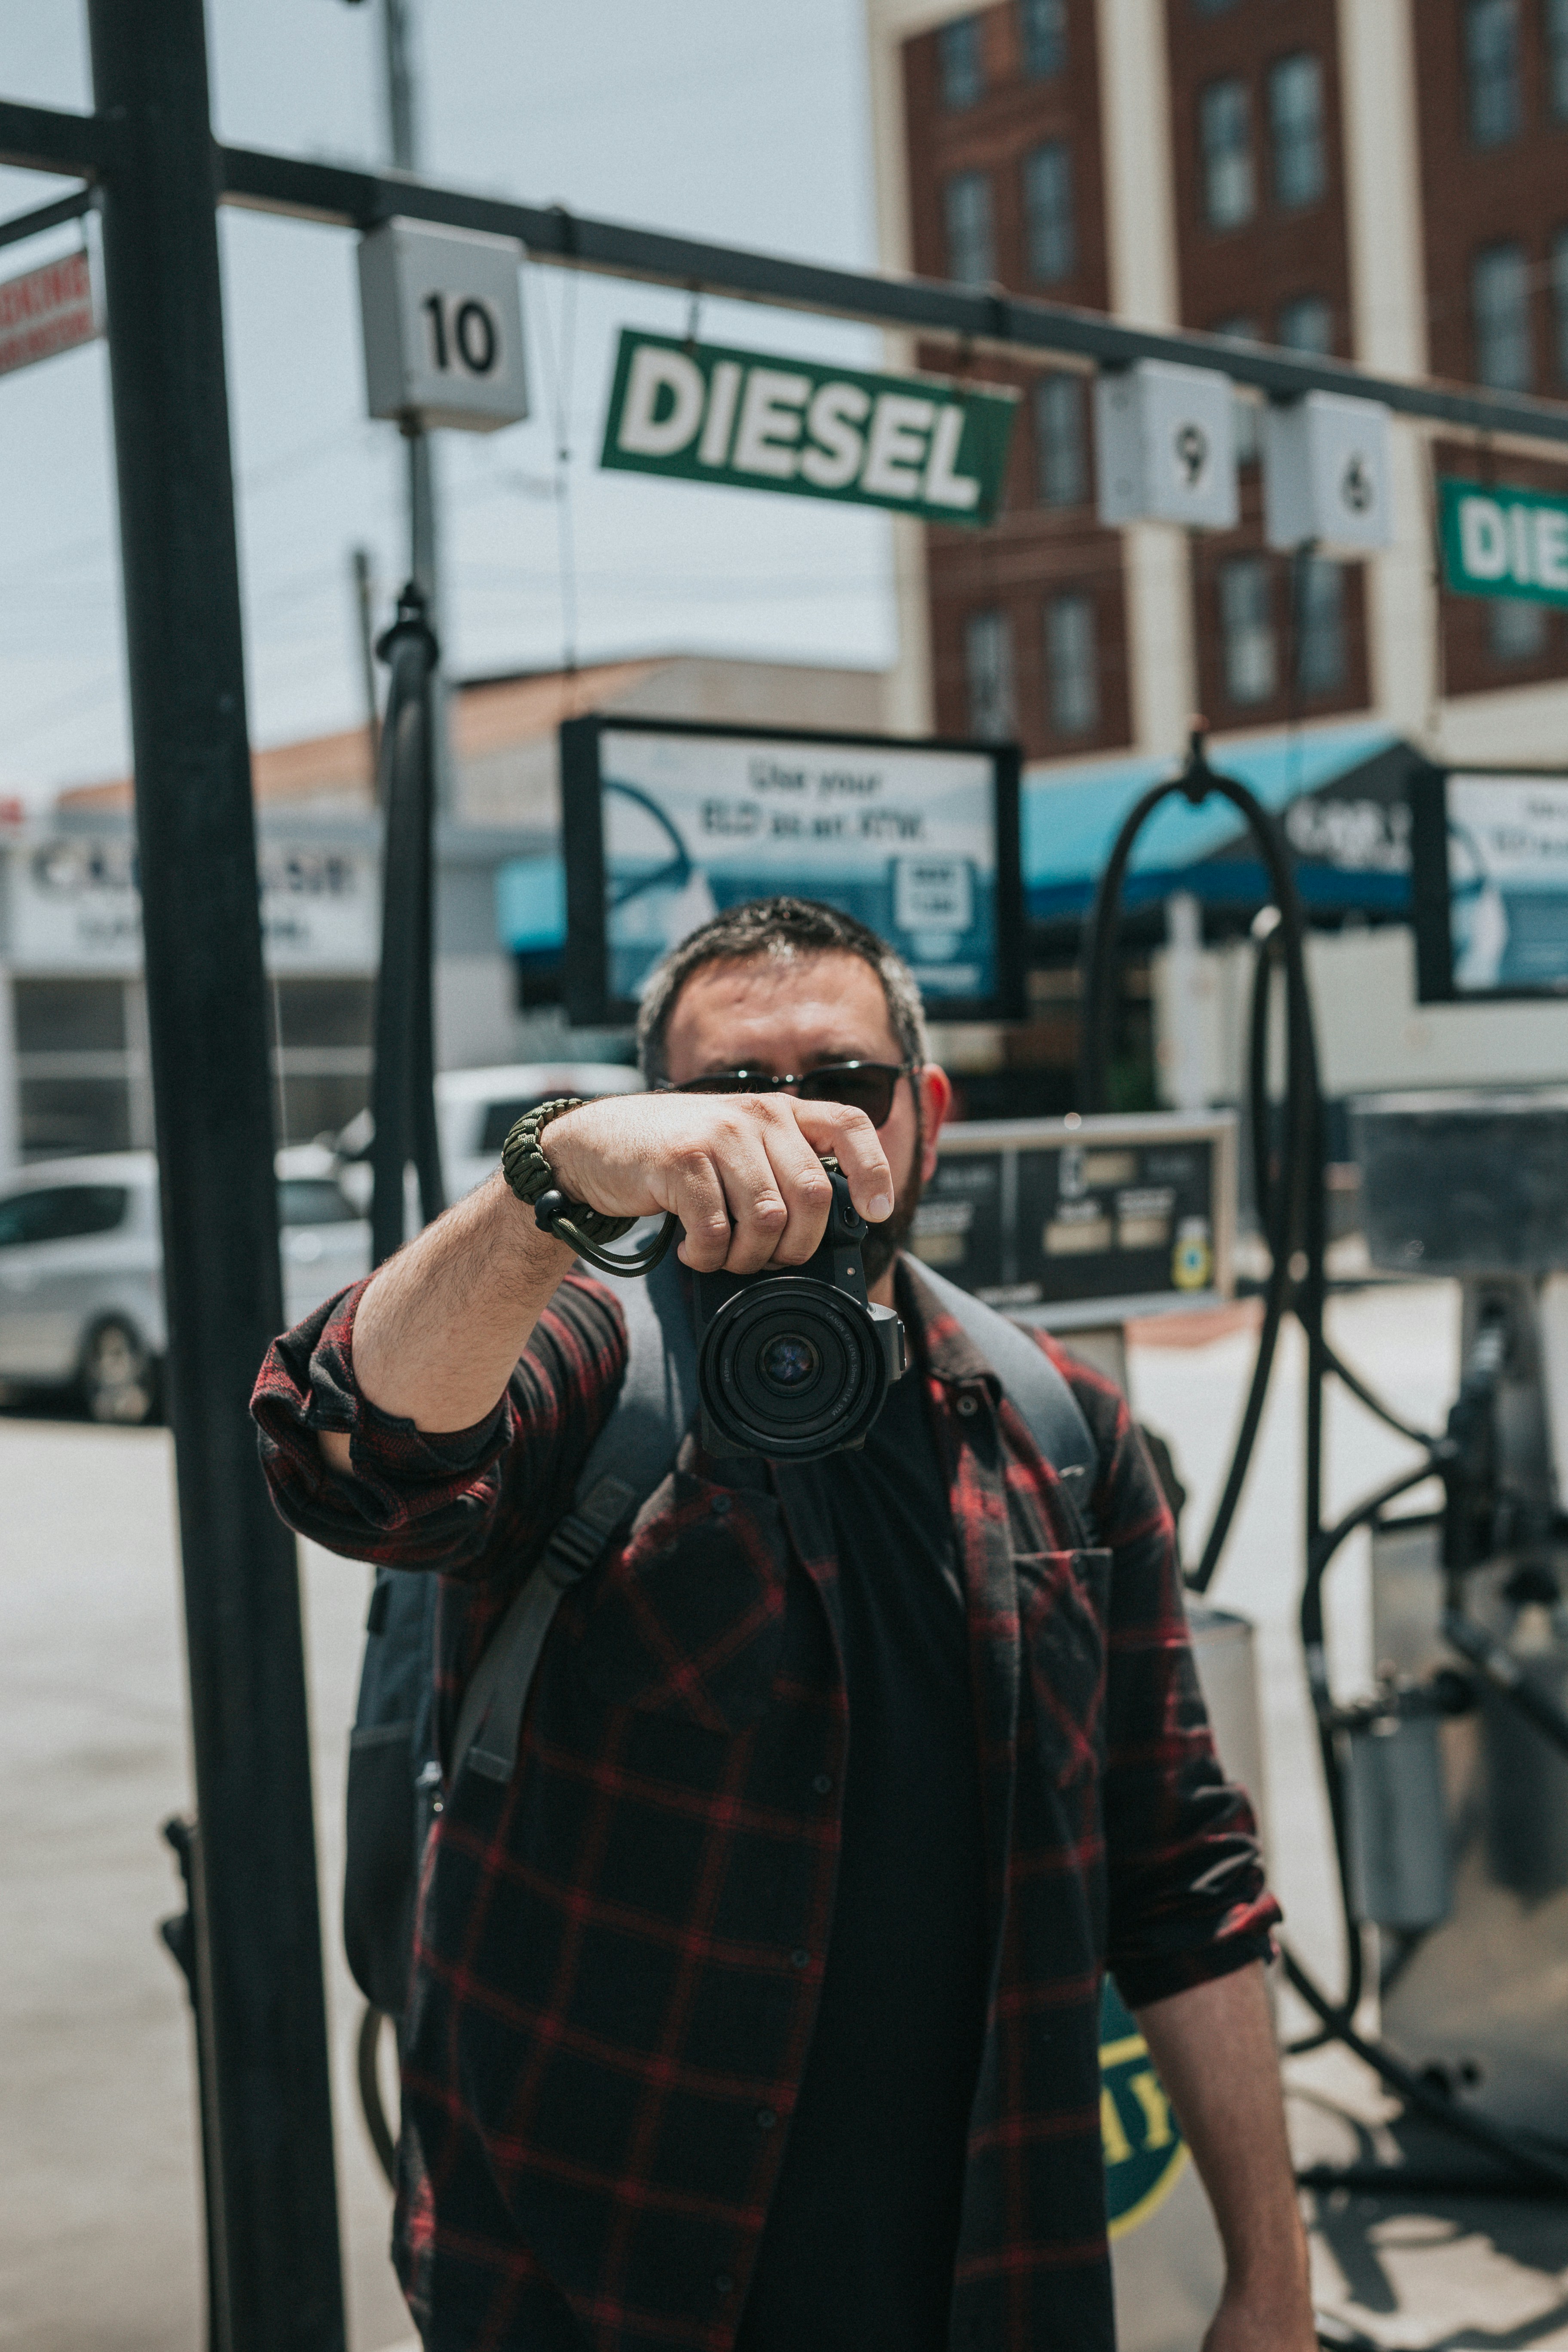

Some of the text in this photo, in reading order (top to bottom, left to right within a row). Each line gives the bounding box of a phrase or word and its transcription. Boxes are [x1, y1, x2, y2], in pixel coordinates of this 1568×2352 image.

[420, 292, 495, 372] 10
[617, 344, 982, 511] DIESEL
[1175, 425, 1208, 490] 9
[1341, 452, 1372, 513] 6
[1458, 496, 1568, 592] DIE
[747, 757, 884, 801] Use your
[826, 1312, 845, 1332] CANON
[848, 1344, 857, 1360] LENS
[832, 1403, 843, 1416] STM
[842, 1388, 853, 1402] 1:1.8
